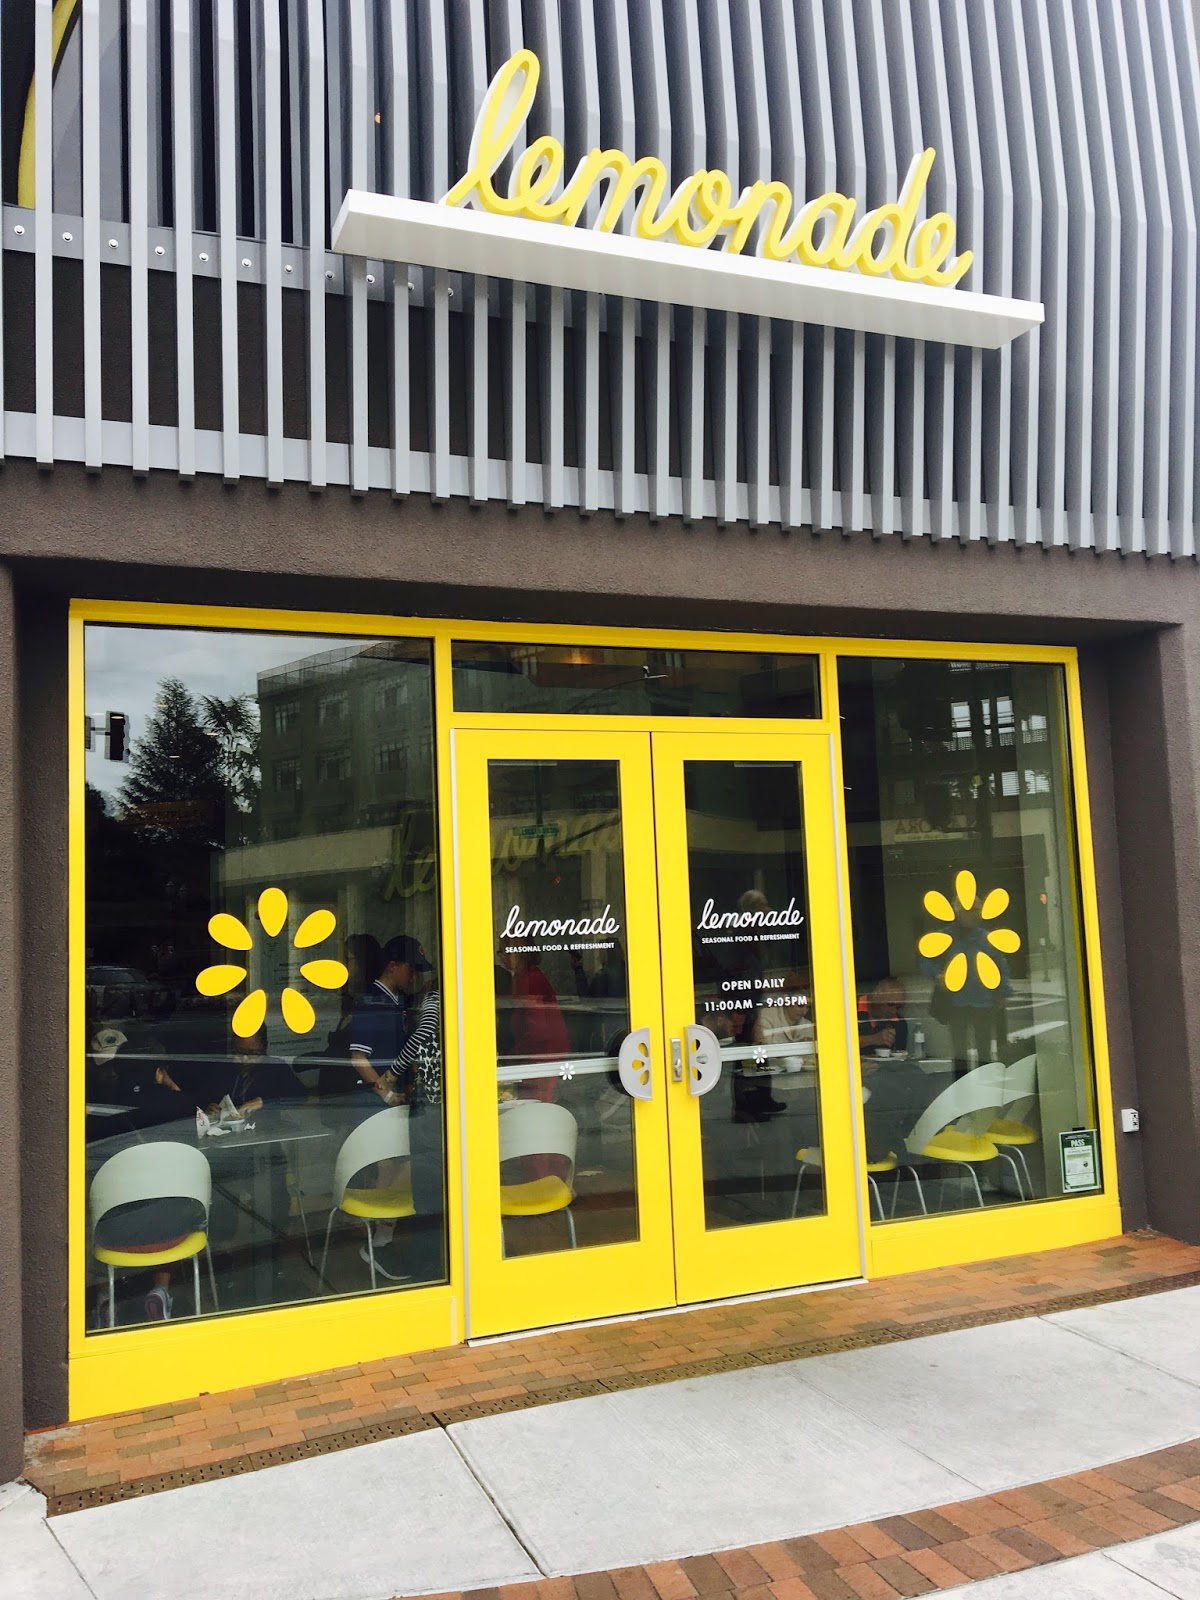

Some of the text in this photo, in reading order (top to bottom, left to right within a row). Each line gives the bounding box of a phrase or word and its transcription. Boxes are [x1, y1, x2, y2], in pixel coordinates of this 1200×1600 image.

[445, 47, 974, 288] lemonade
[500, 904, 620, 939] lemonade
[697, 897, 804, 930] lemonade
[701, 933, 800, 945] SEASONAL FOOD & REFRESHMENT
[505, 942, 615, 954] SEASONAL FOOD & REFRESHMENT
[721, 977, 785, 992] OPEN DAILY
[704, 999, 753, 1012] 11:00AM
[766, 995, 808, 1008] 9:05PM
[1070, 1139, 1085, 1147] PASS
